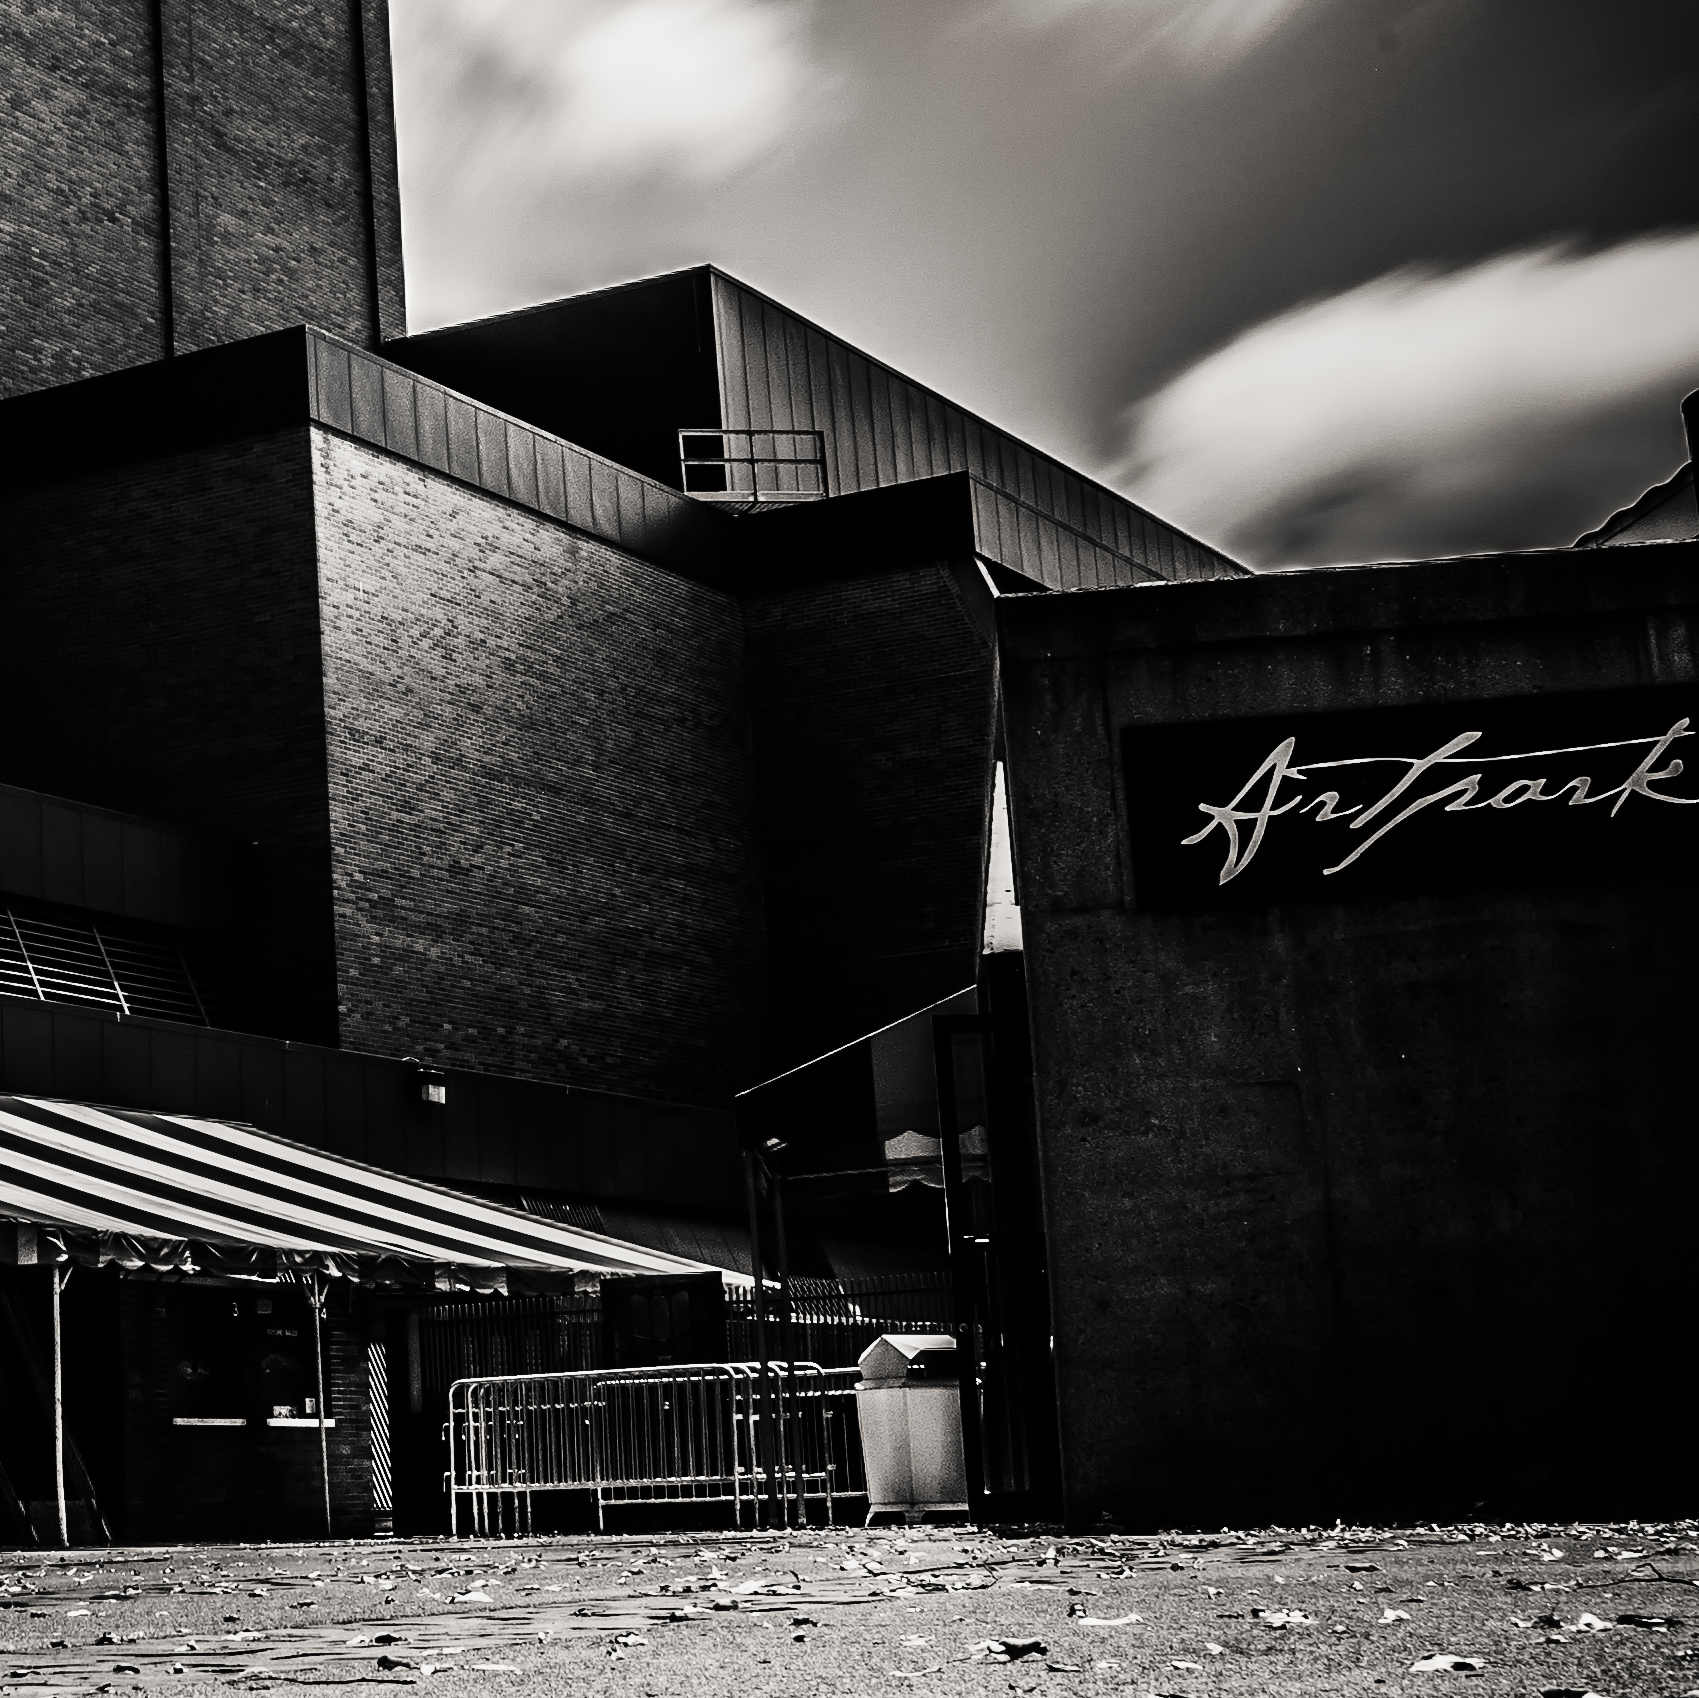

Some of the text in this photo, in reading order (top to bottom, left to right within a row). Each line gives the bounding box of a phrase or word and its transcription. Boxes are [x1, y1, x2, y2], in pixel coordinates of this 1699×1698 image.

[1181, 717, 1699, 885] Artpark
[232, 1302, 239, 1317] 3
[320, 1307, 327, 1321] 4
